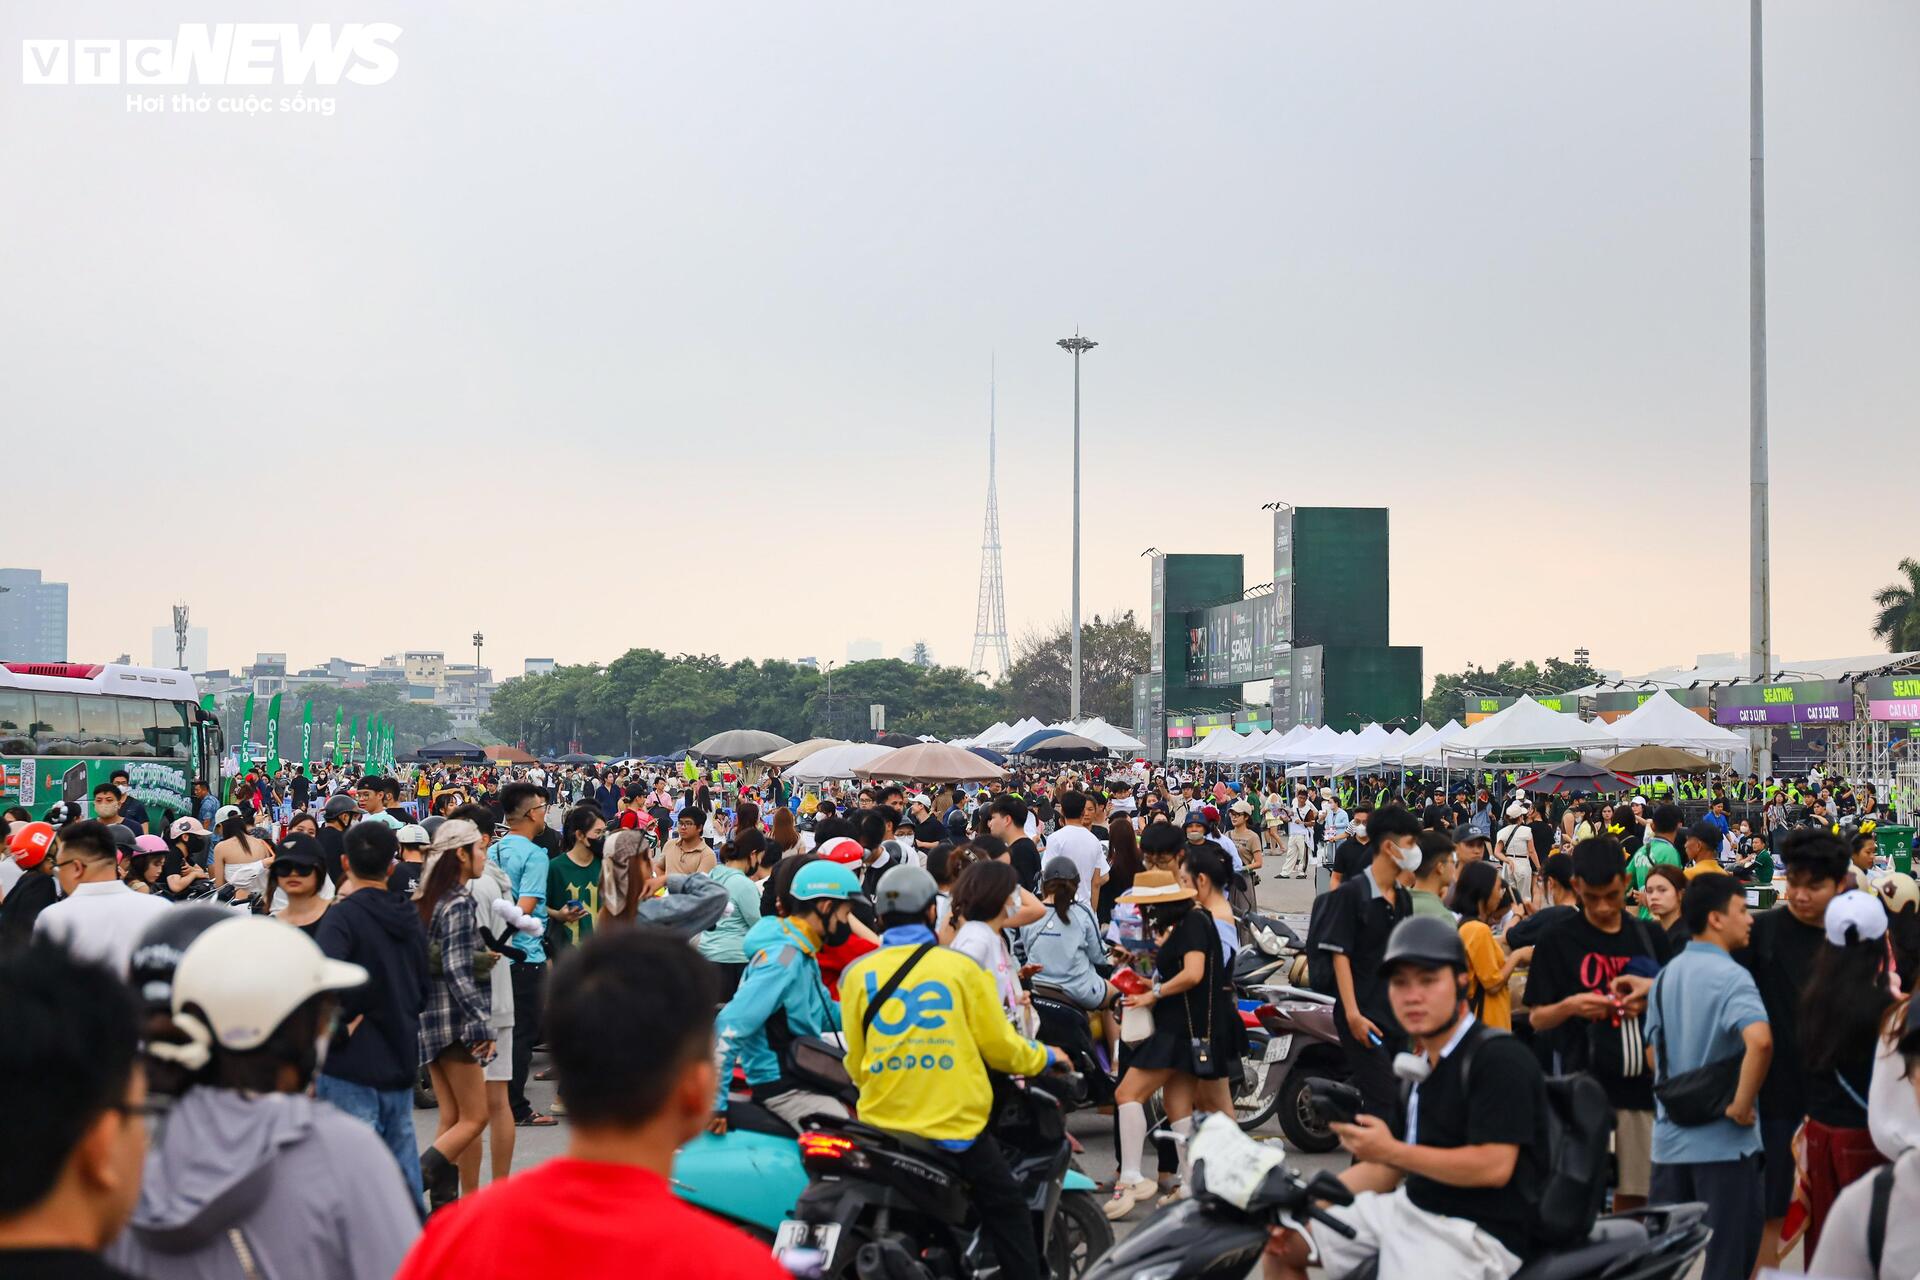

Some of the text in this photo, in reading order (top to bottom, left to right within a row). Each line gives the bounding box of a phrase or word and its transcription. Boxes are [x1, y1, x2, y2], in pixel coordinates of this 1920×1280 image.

[1231, 636, 1252, 661] SPARK
[1763, 687, 1793, 703] SEATING
[1740, 709, 1750, 721] CAT
[1750, 709, 1754, 721] 3
[1808, 705, 1839, 720] CAT 3 L2/R2
[1889, 703, 1902, 717] CAT
[268, 718, 277, 760] Grab
[865, 970, 953, 1036] be
